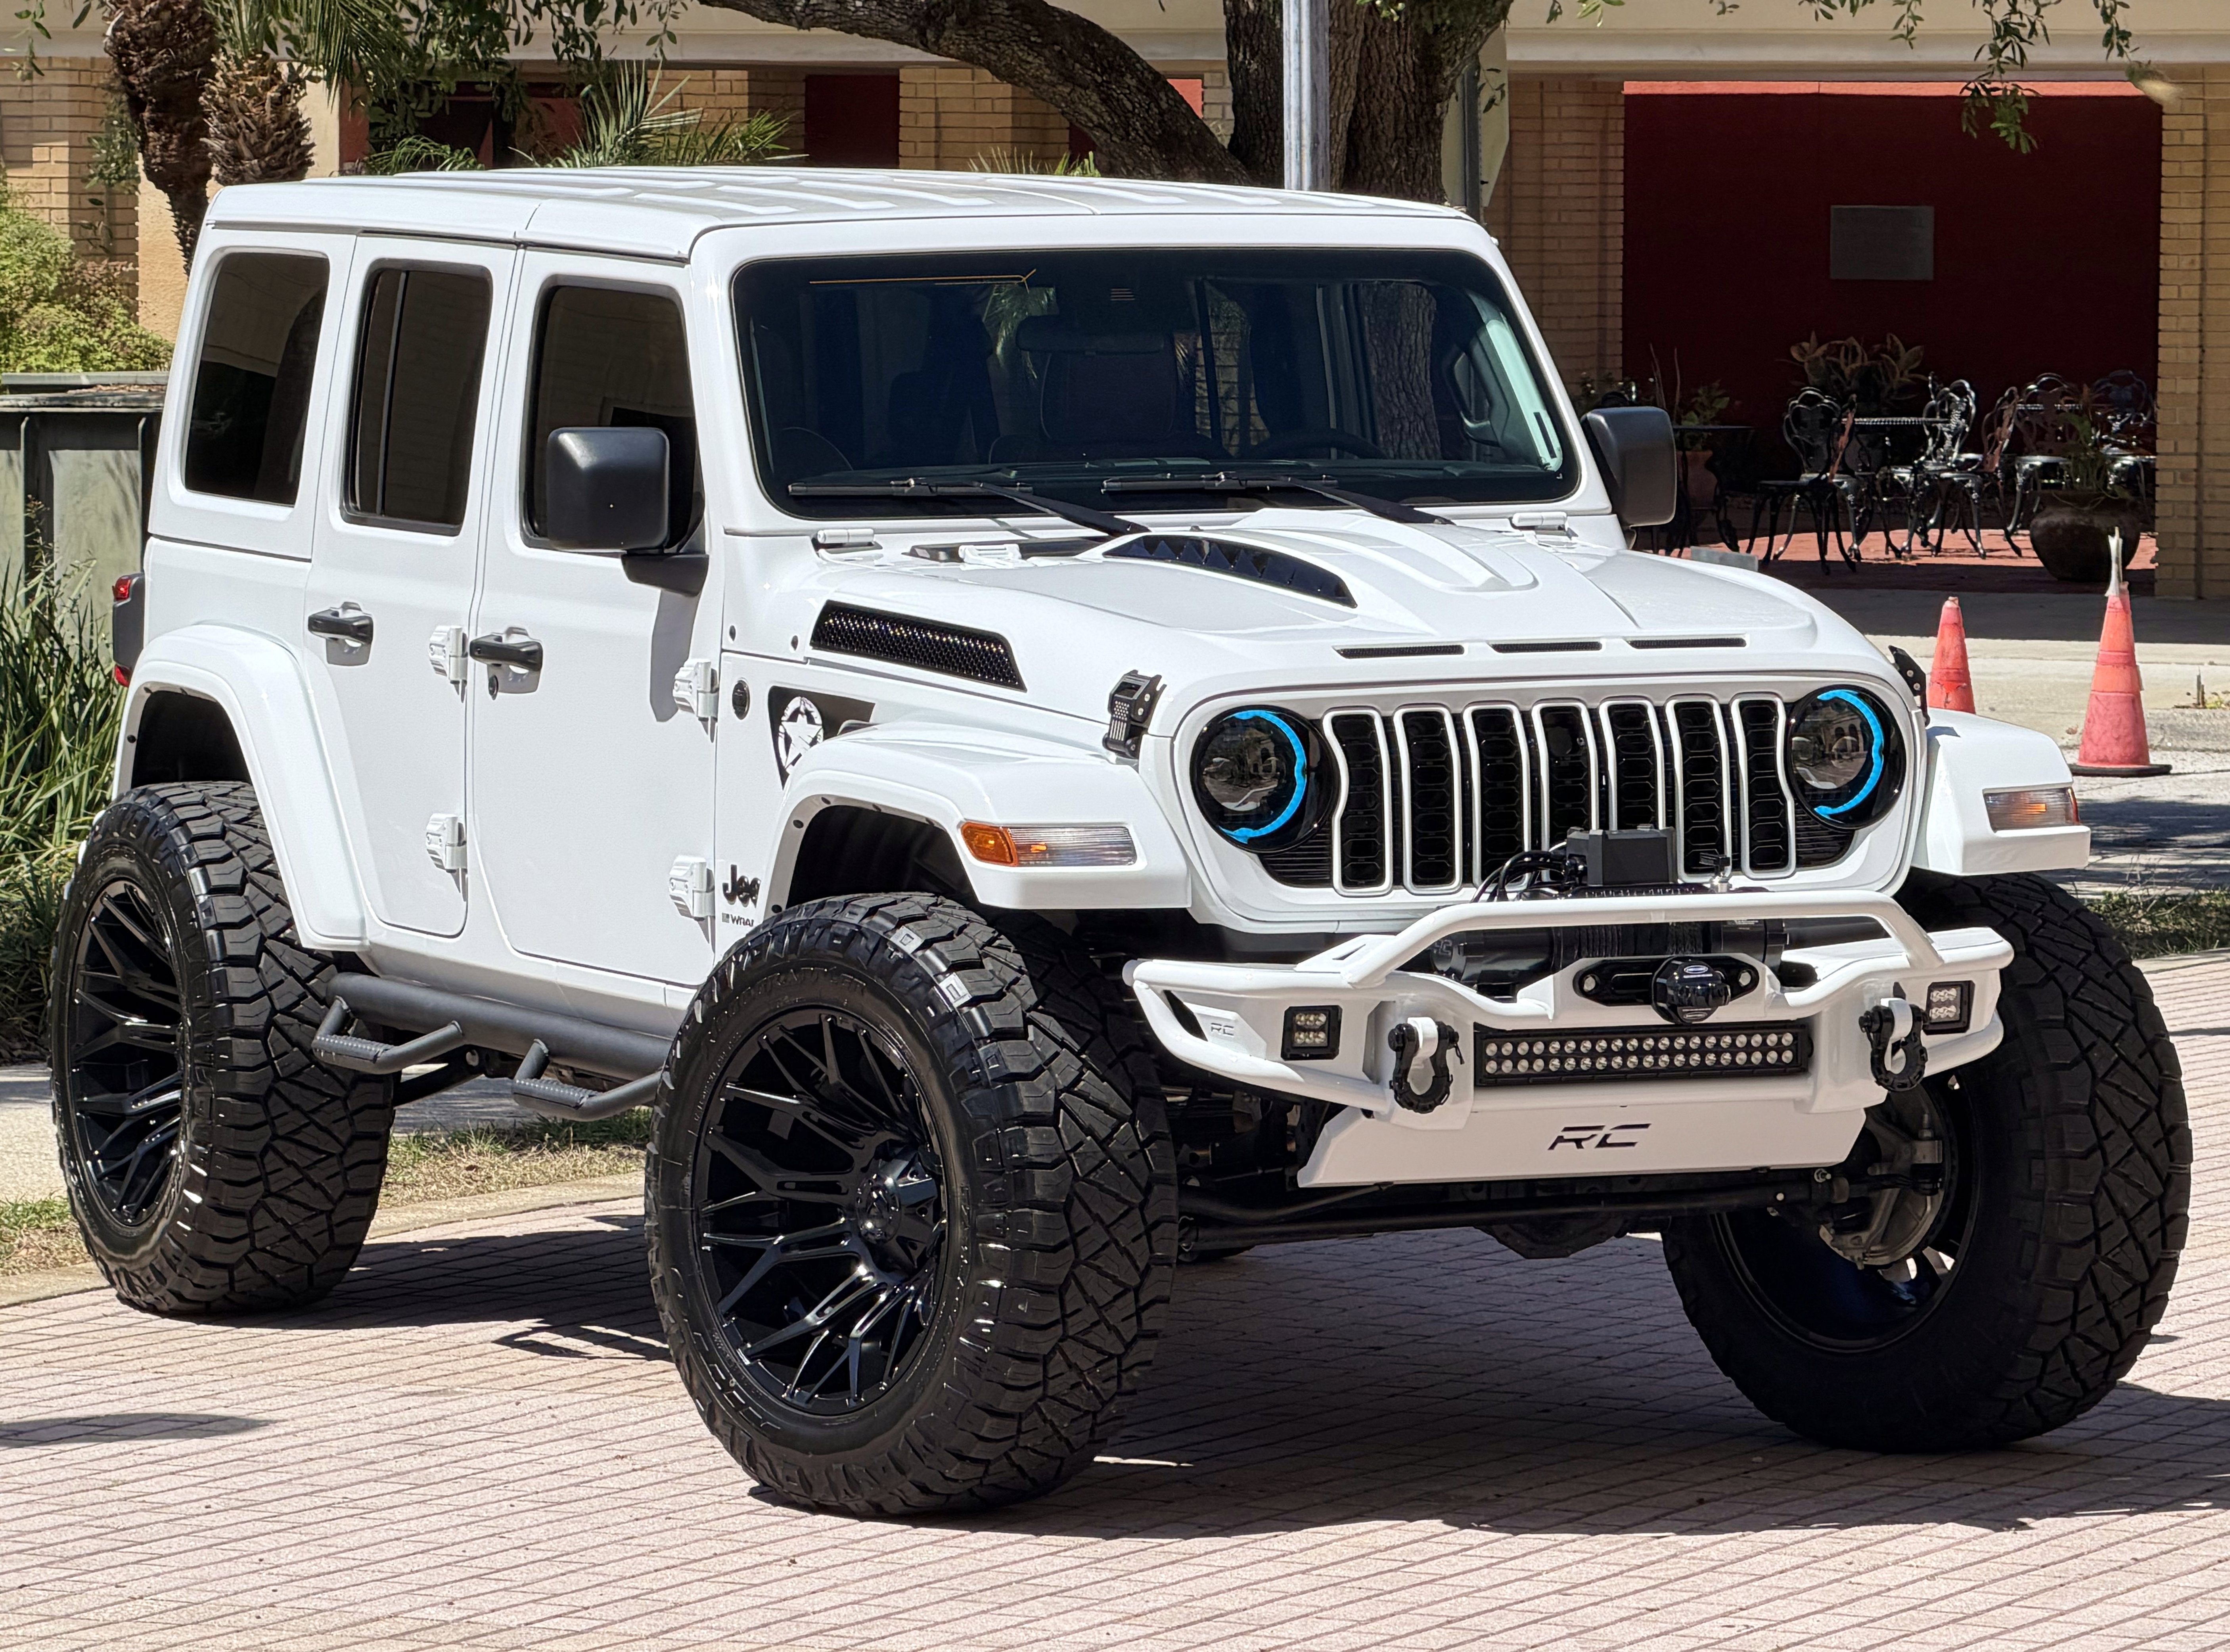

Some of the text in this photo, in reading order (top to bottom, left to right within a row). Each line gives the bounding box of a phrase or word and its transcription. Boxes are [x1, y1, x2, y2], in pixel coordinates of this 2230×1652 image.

[722, 864, 761, 908] Jee
[1211, 1022, 1234, 1036] RC
[1548, 1123, 1651, 1150] RC
